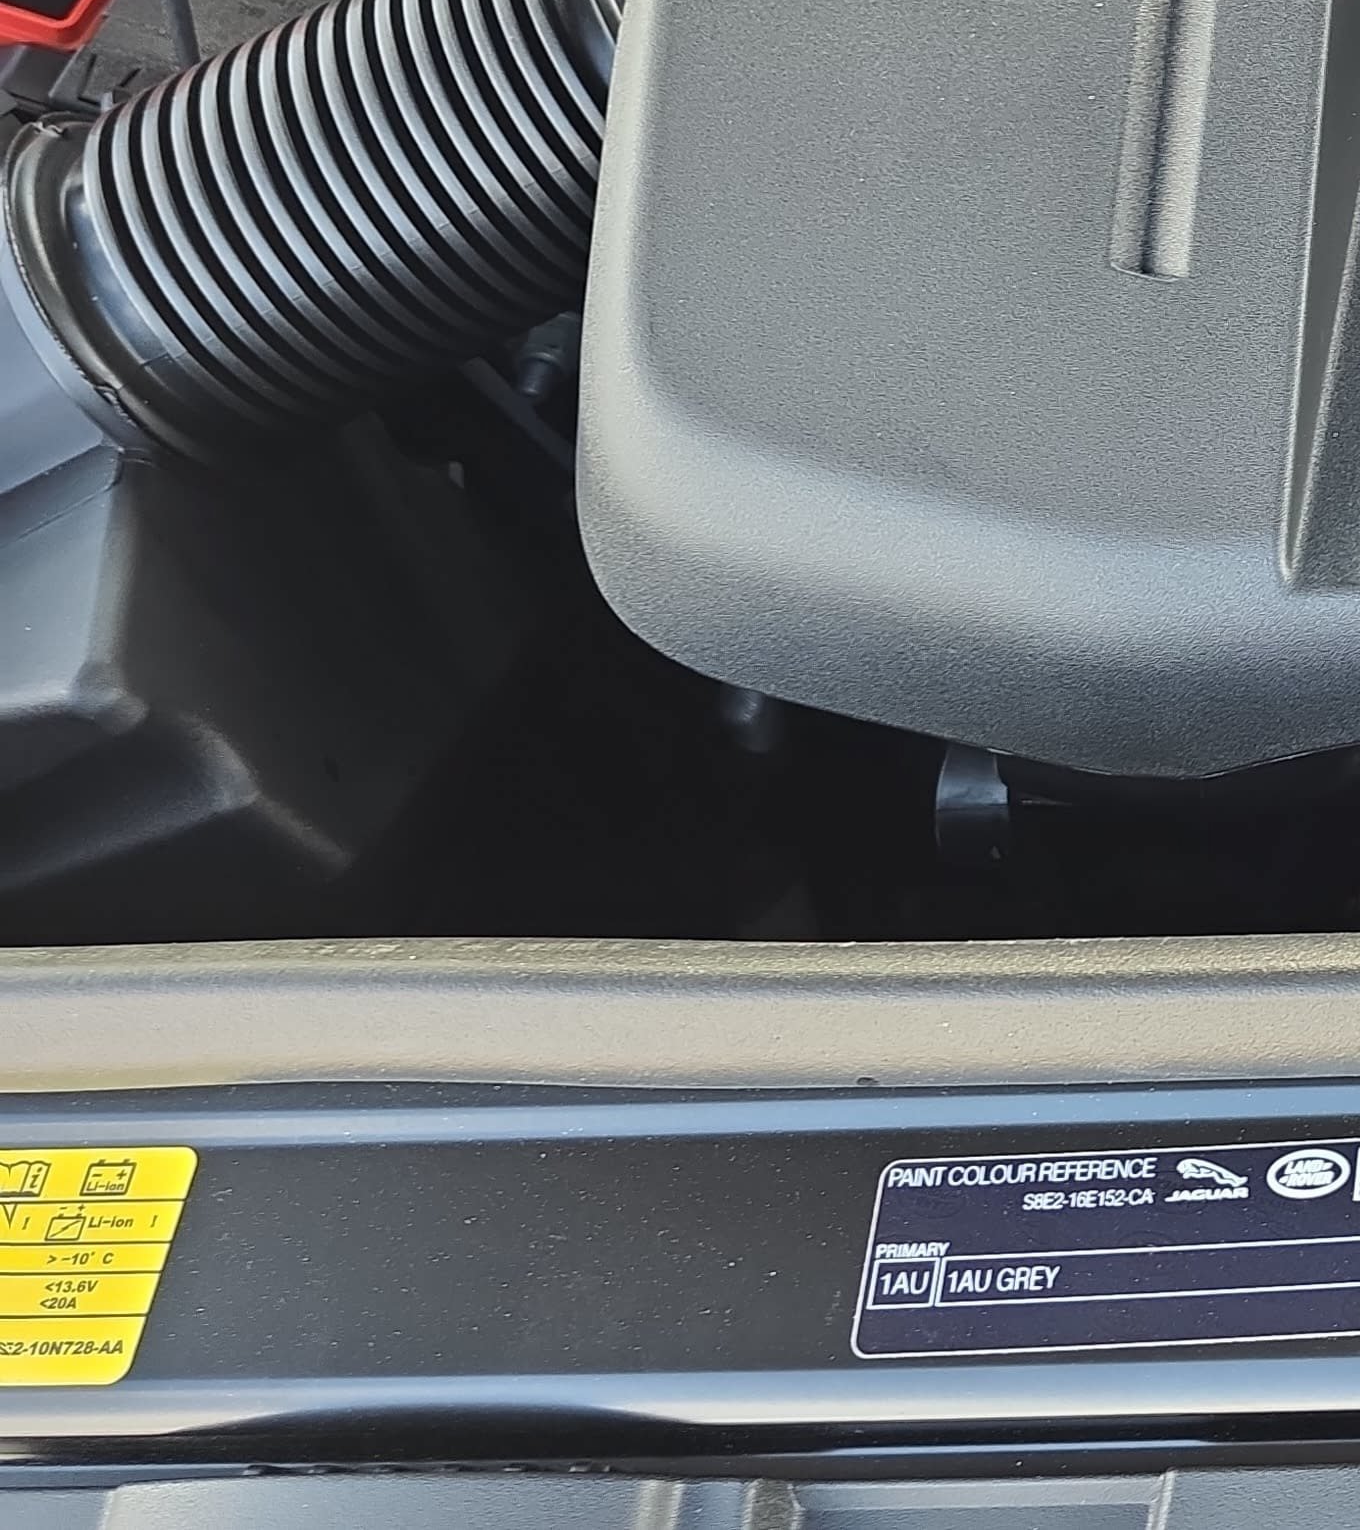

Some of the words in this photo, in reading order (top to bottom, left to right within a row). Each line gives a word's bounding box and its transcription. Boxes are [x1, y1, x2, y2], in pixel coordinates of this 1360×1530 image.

[888, 1166, 948, 1187] PAINT
[947, 1163, 1035, 1186] COLOUR
[1038, 1157, 1157, 1182] REFERENCE
[1022, 1188, 1155, 1211] S8E2-16E152-CA
[1164, 1187, 1249, 1202] JAGUAR
[88, 1215, 134, 1228] Li-ion
[875, 1242, 950, 1258] PRIMARY
[880, 1271, 930, 1295] 1AU
[947, 1269, 993, 1293] 1AU
[996, 1266, 1060, 1291] GREY
